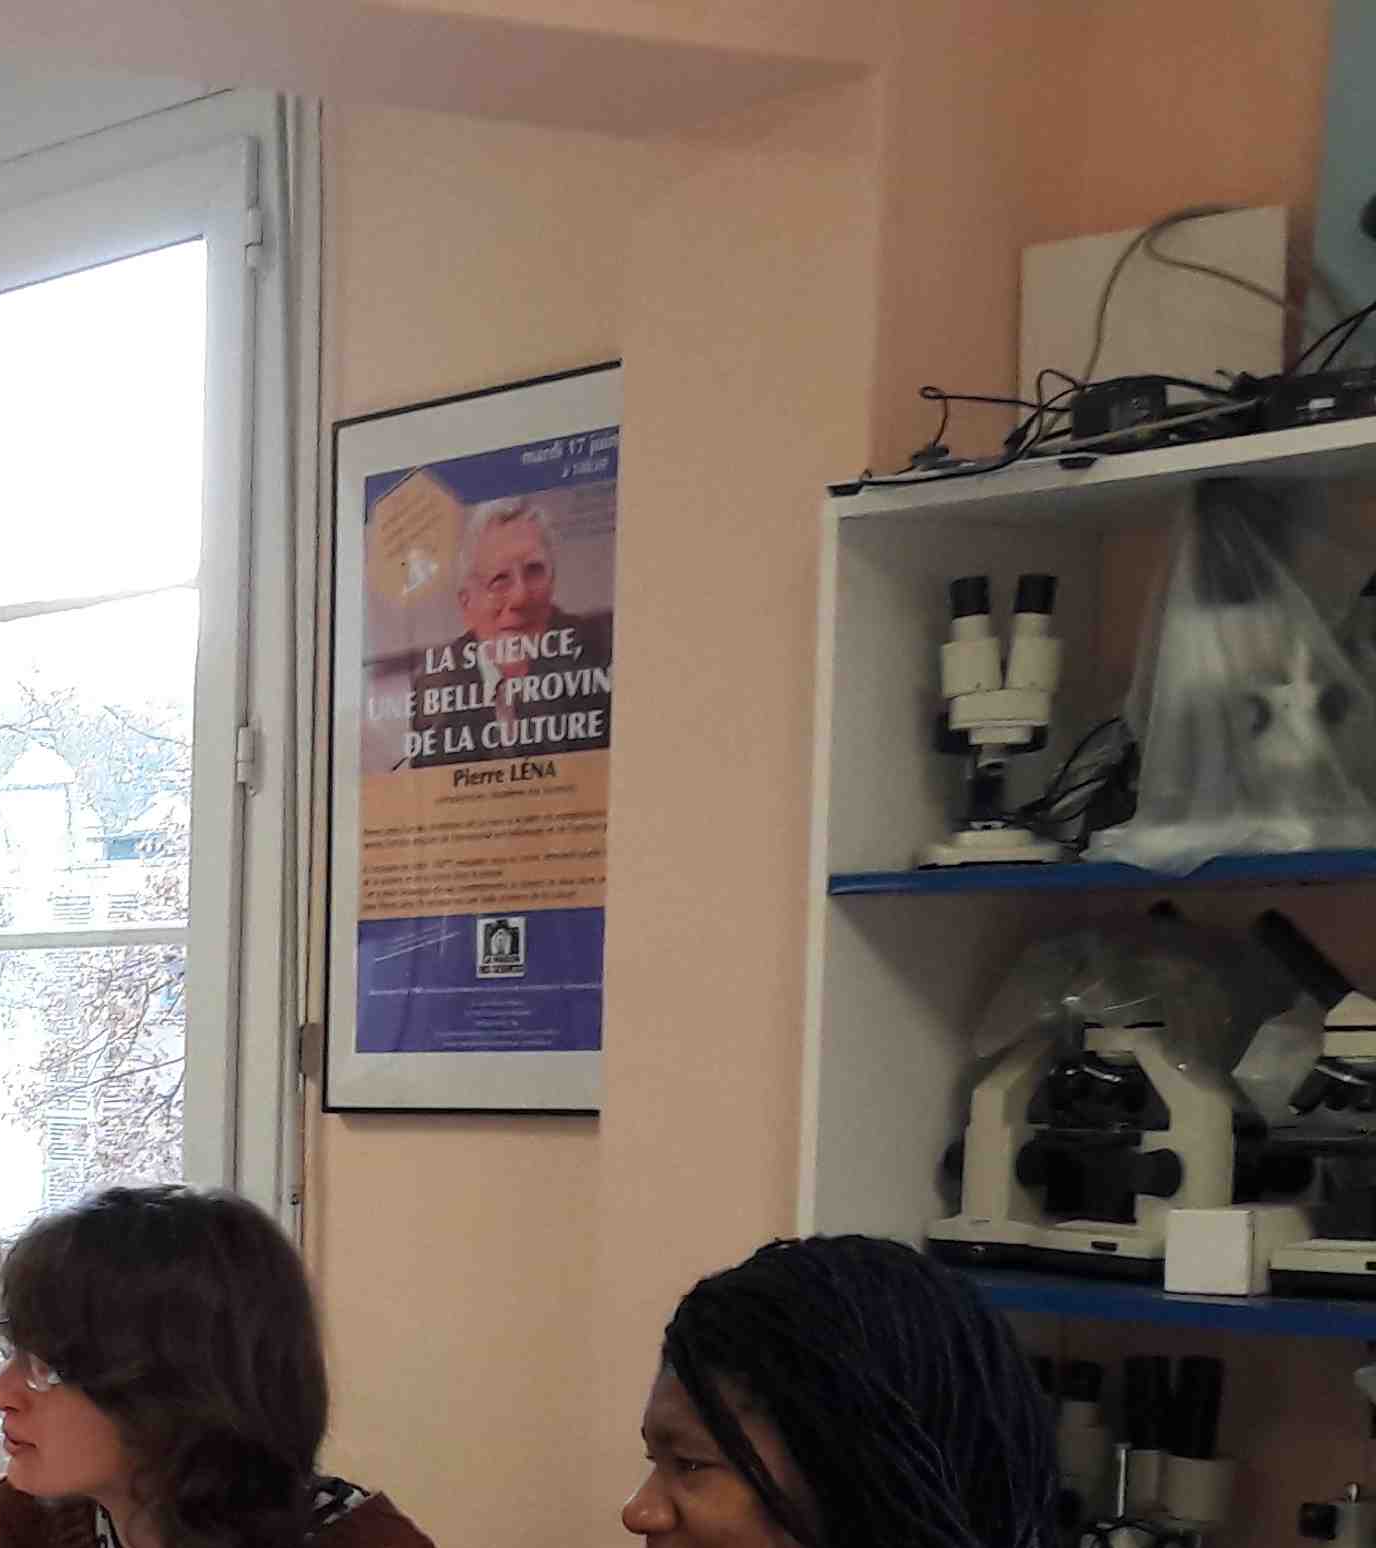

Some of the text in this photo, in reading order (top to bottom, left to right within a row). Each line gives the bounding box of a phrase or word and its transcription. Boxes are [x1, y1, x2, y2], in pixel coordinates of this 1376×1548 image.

[424, 627, 584, 675] LA SCIENCE,
[423, 679, 497, 716] BELLE
[403, 709, 605, 760] DE LA CULTURE
[452, 767, 505, 788] Pierre
